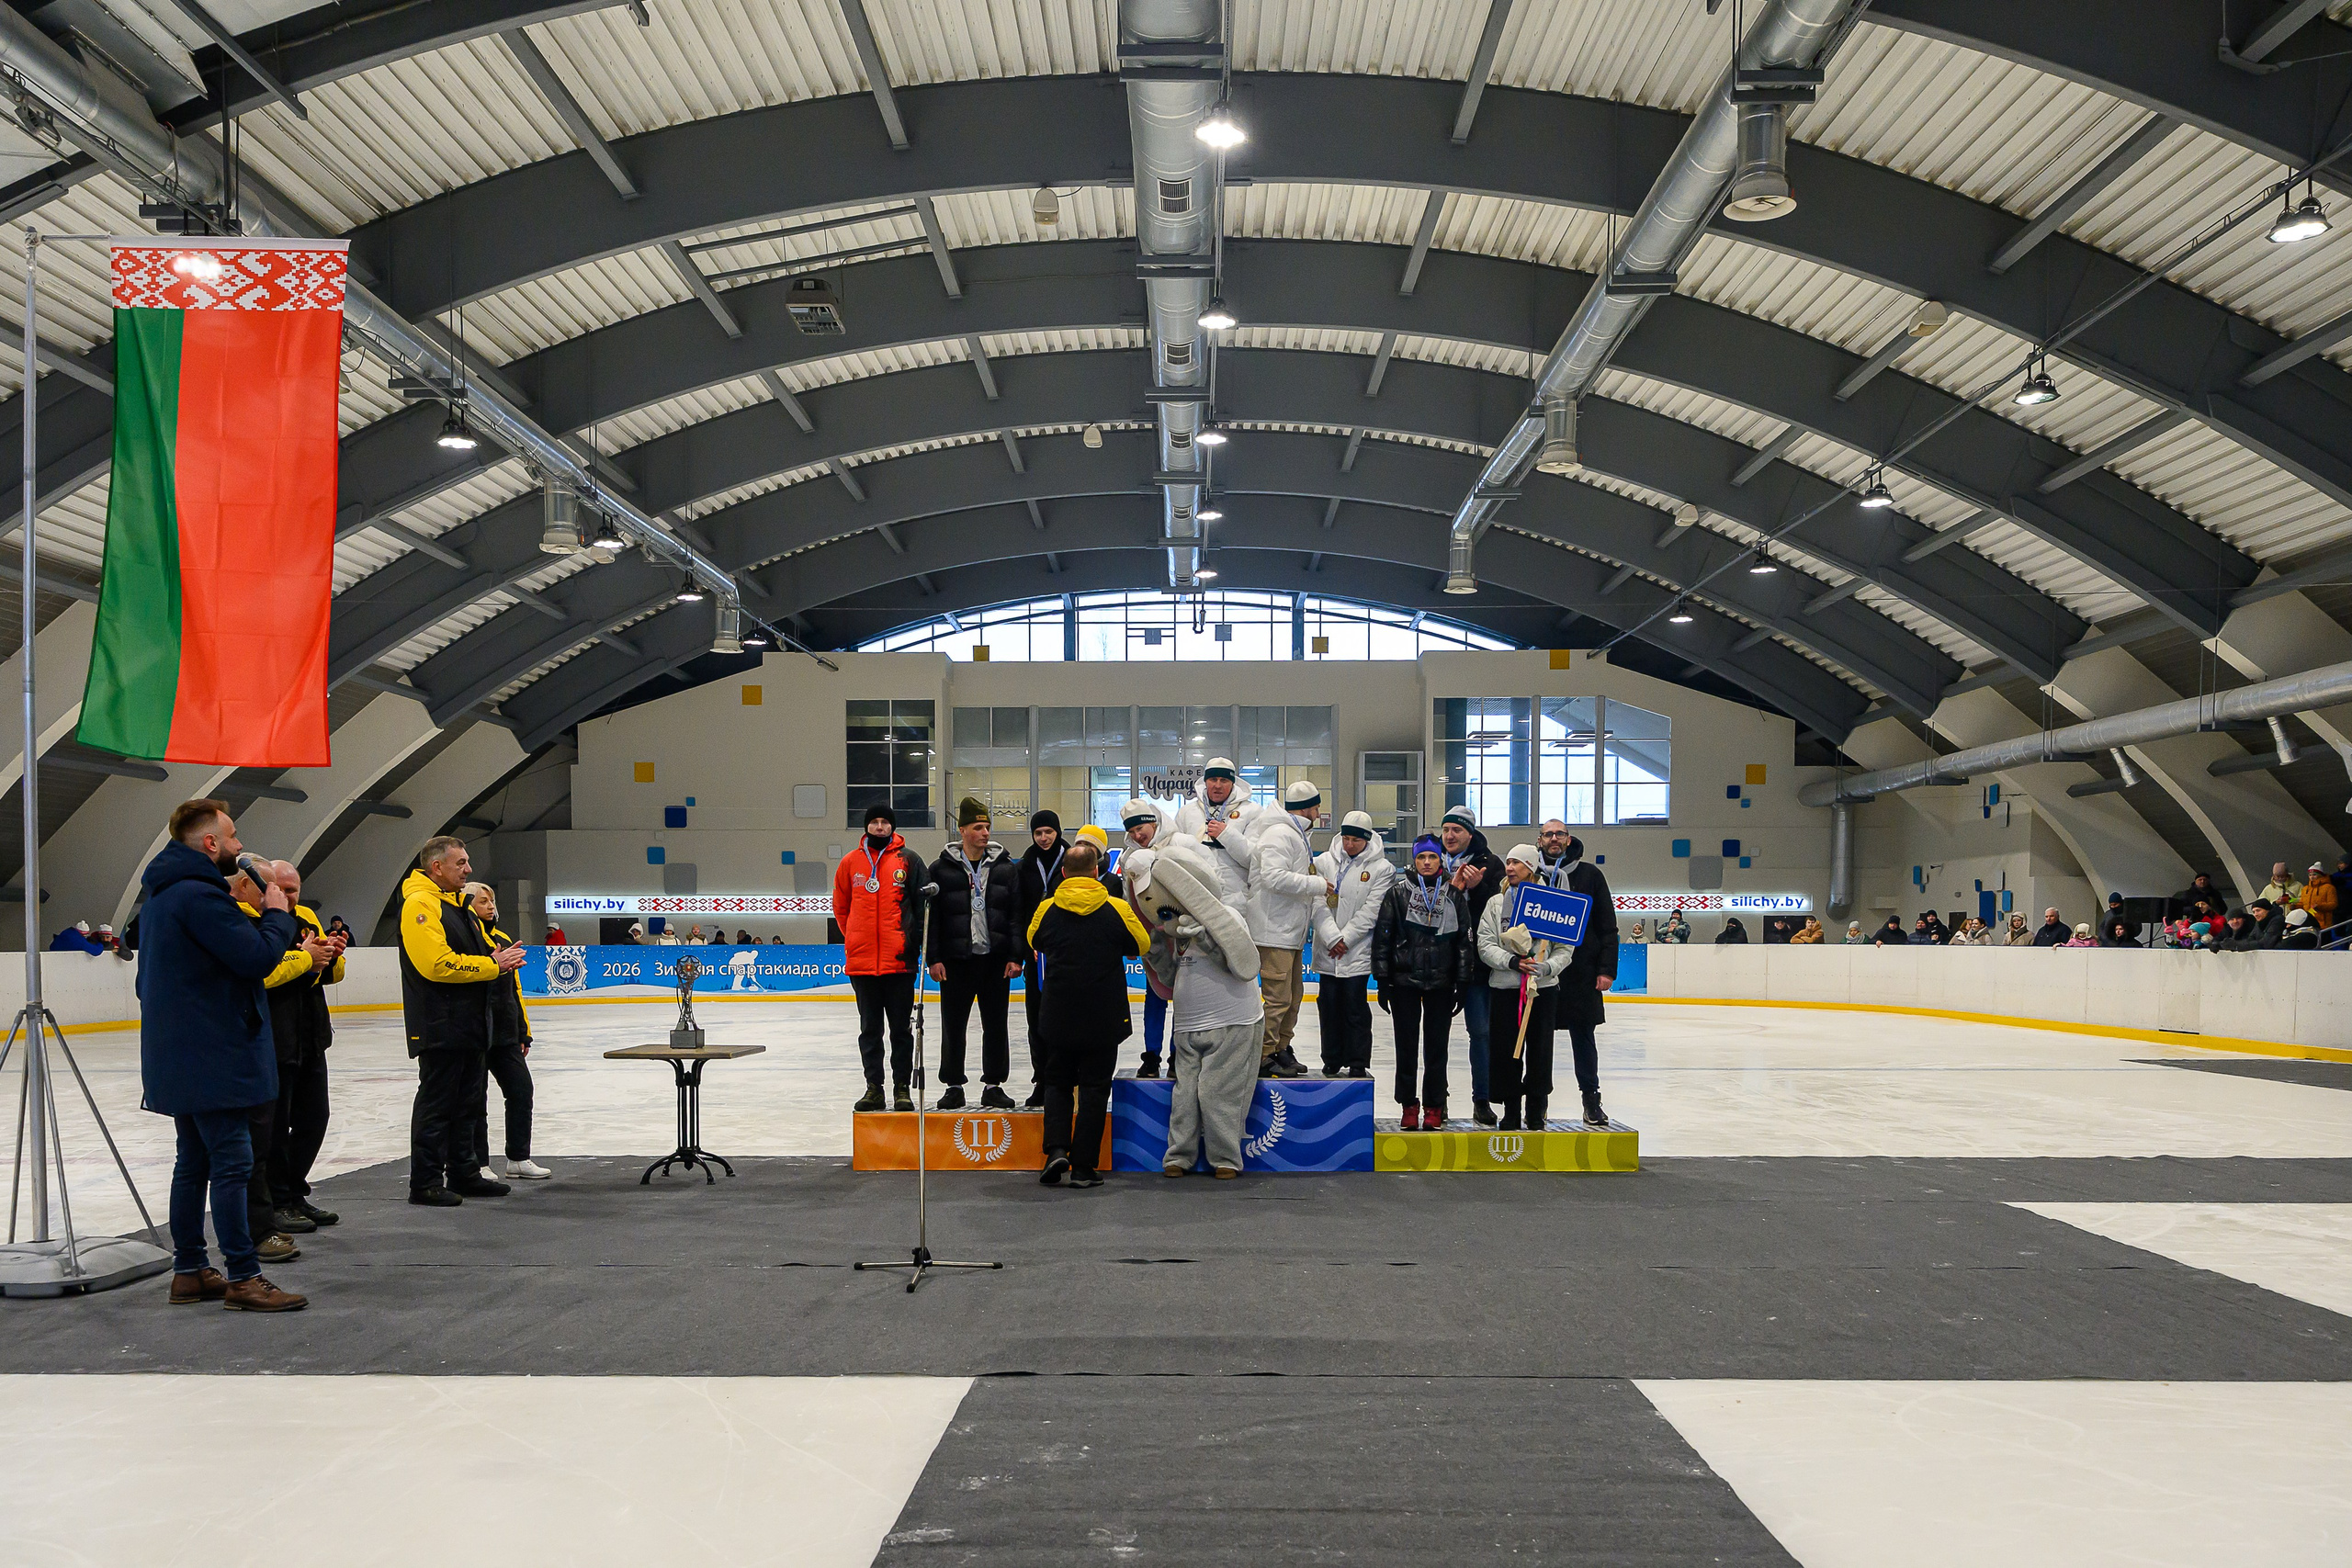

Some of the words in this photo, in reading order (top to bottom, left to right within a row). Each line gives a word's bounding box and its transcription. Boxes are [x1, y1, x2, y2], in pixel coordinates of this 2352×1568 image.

[1144, 775, 1197, 796] Чараў
[554, 898, 625, 910] silichy.by
[1731, 897, 1804, 908] silichy.by
[1523, 901, 1577, 926] Единые
[445, 961, 481, 973] BELARUS
[603, 963, 641, 976] 2026
[718, 964, 820, 978] спартакиада
[968, 1119, 997, 1147] II
[1494, 1135, 1518, 1153] III
